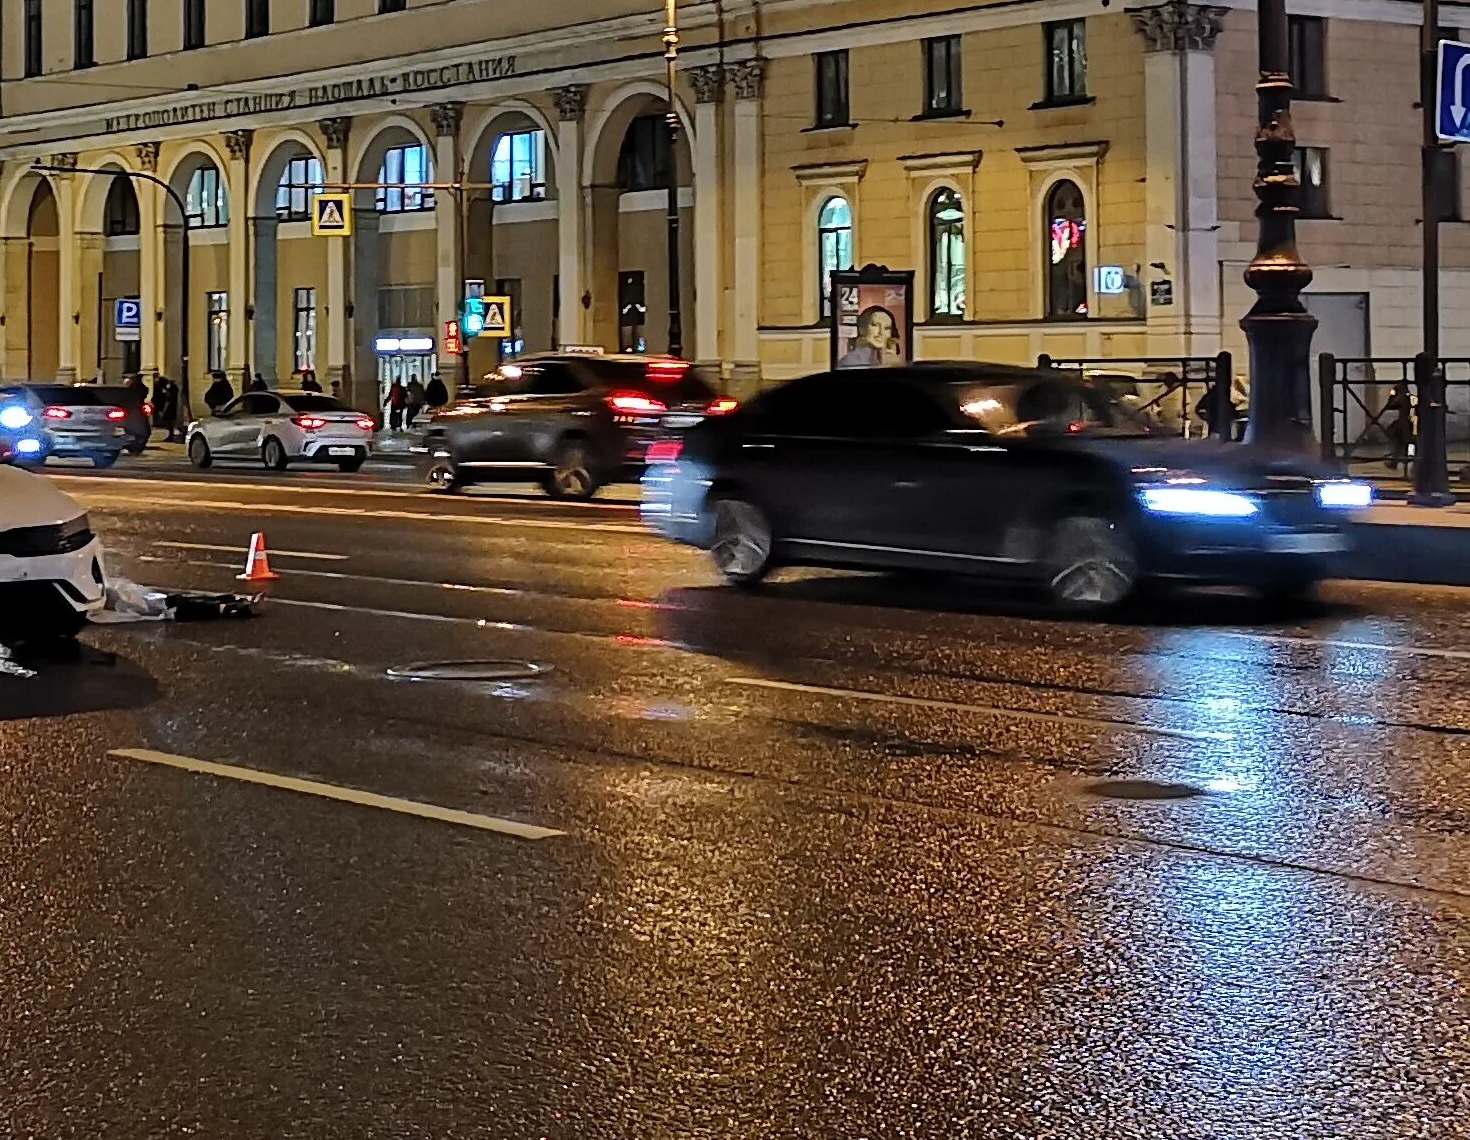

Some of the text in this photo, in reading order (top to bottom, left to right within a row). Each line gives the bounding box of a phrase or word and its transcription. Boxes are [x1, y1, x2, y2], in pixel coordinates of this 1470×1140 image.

[224, 90, 297, 114] СТАНЦИЯ
[402, 55, 517, 89] ВОССТАНИЯ
[841, 287, 858, 305] 24
